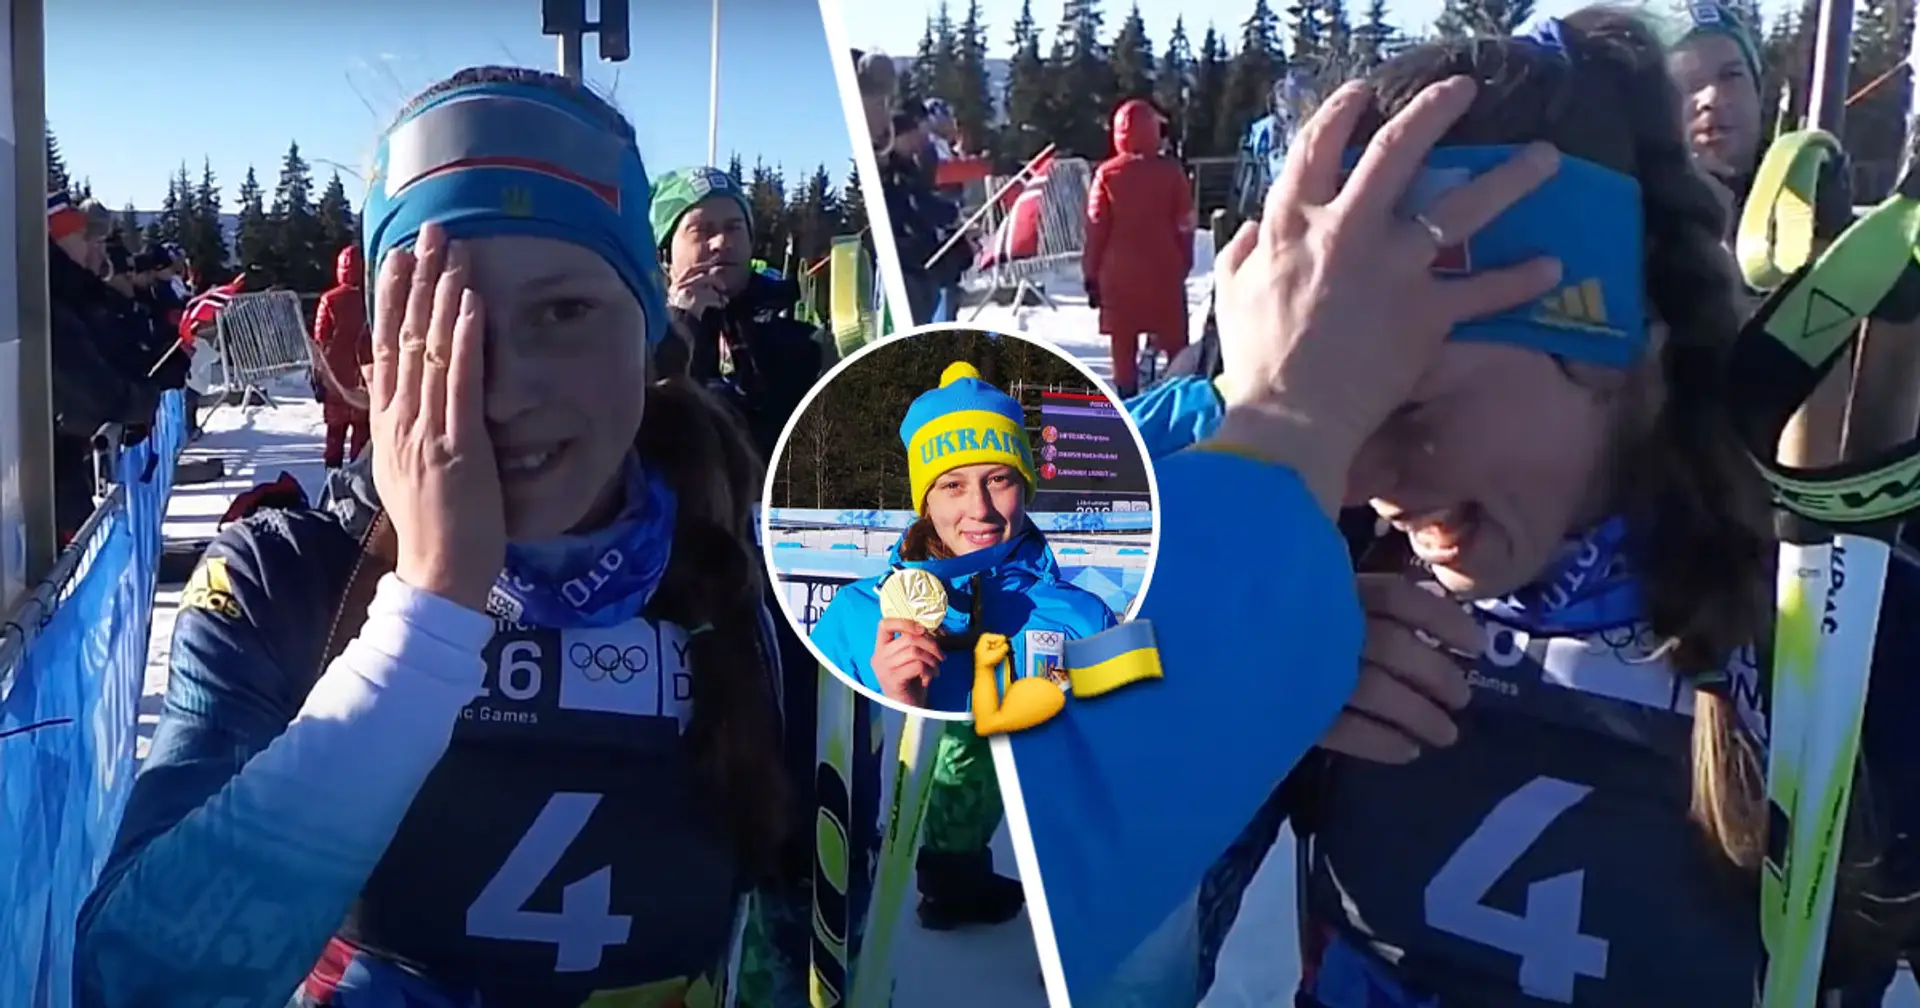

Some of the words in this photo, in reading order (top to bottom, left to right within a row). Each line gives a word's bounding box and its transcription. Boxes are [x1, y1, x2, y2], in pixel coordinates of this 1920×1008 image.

[811, 582, 840, 603] YO
[479, 706, 539, 724] Games
[465, 791, 633, 972] 4
[1424, 774, 1610, 1004] 4
